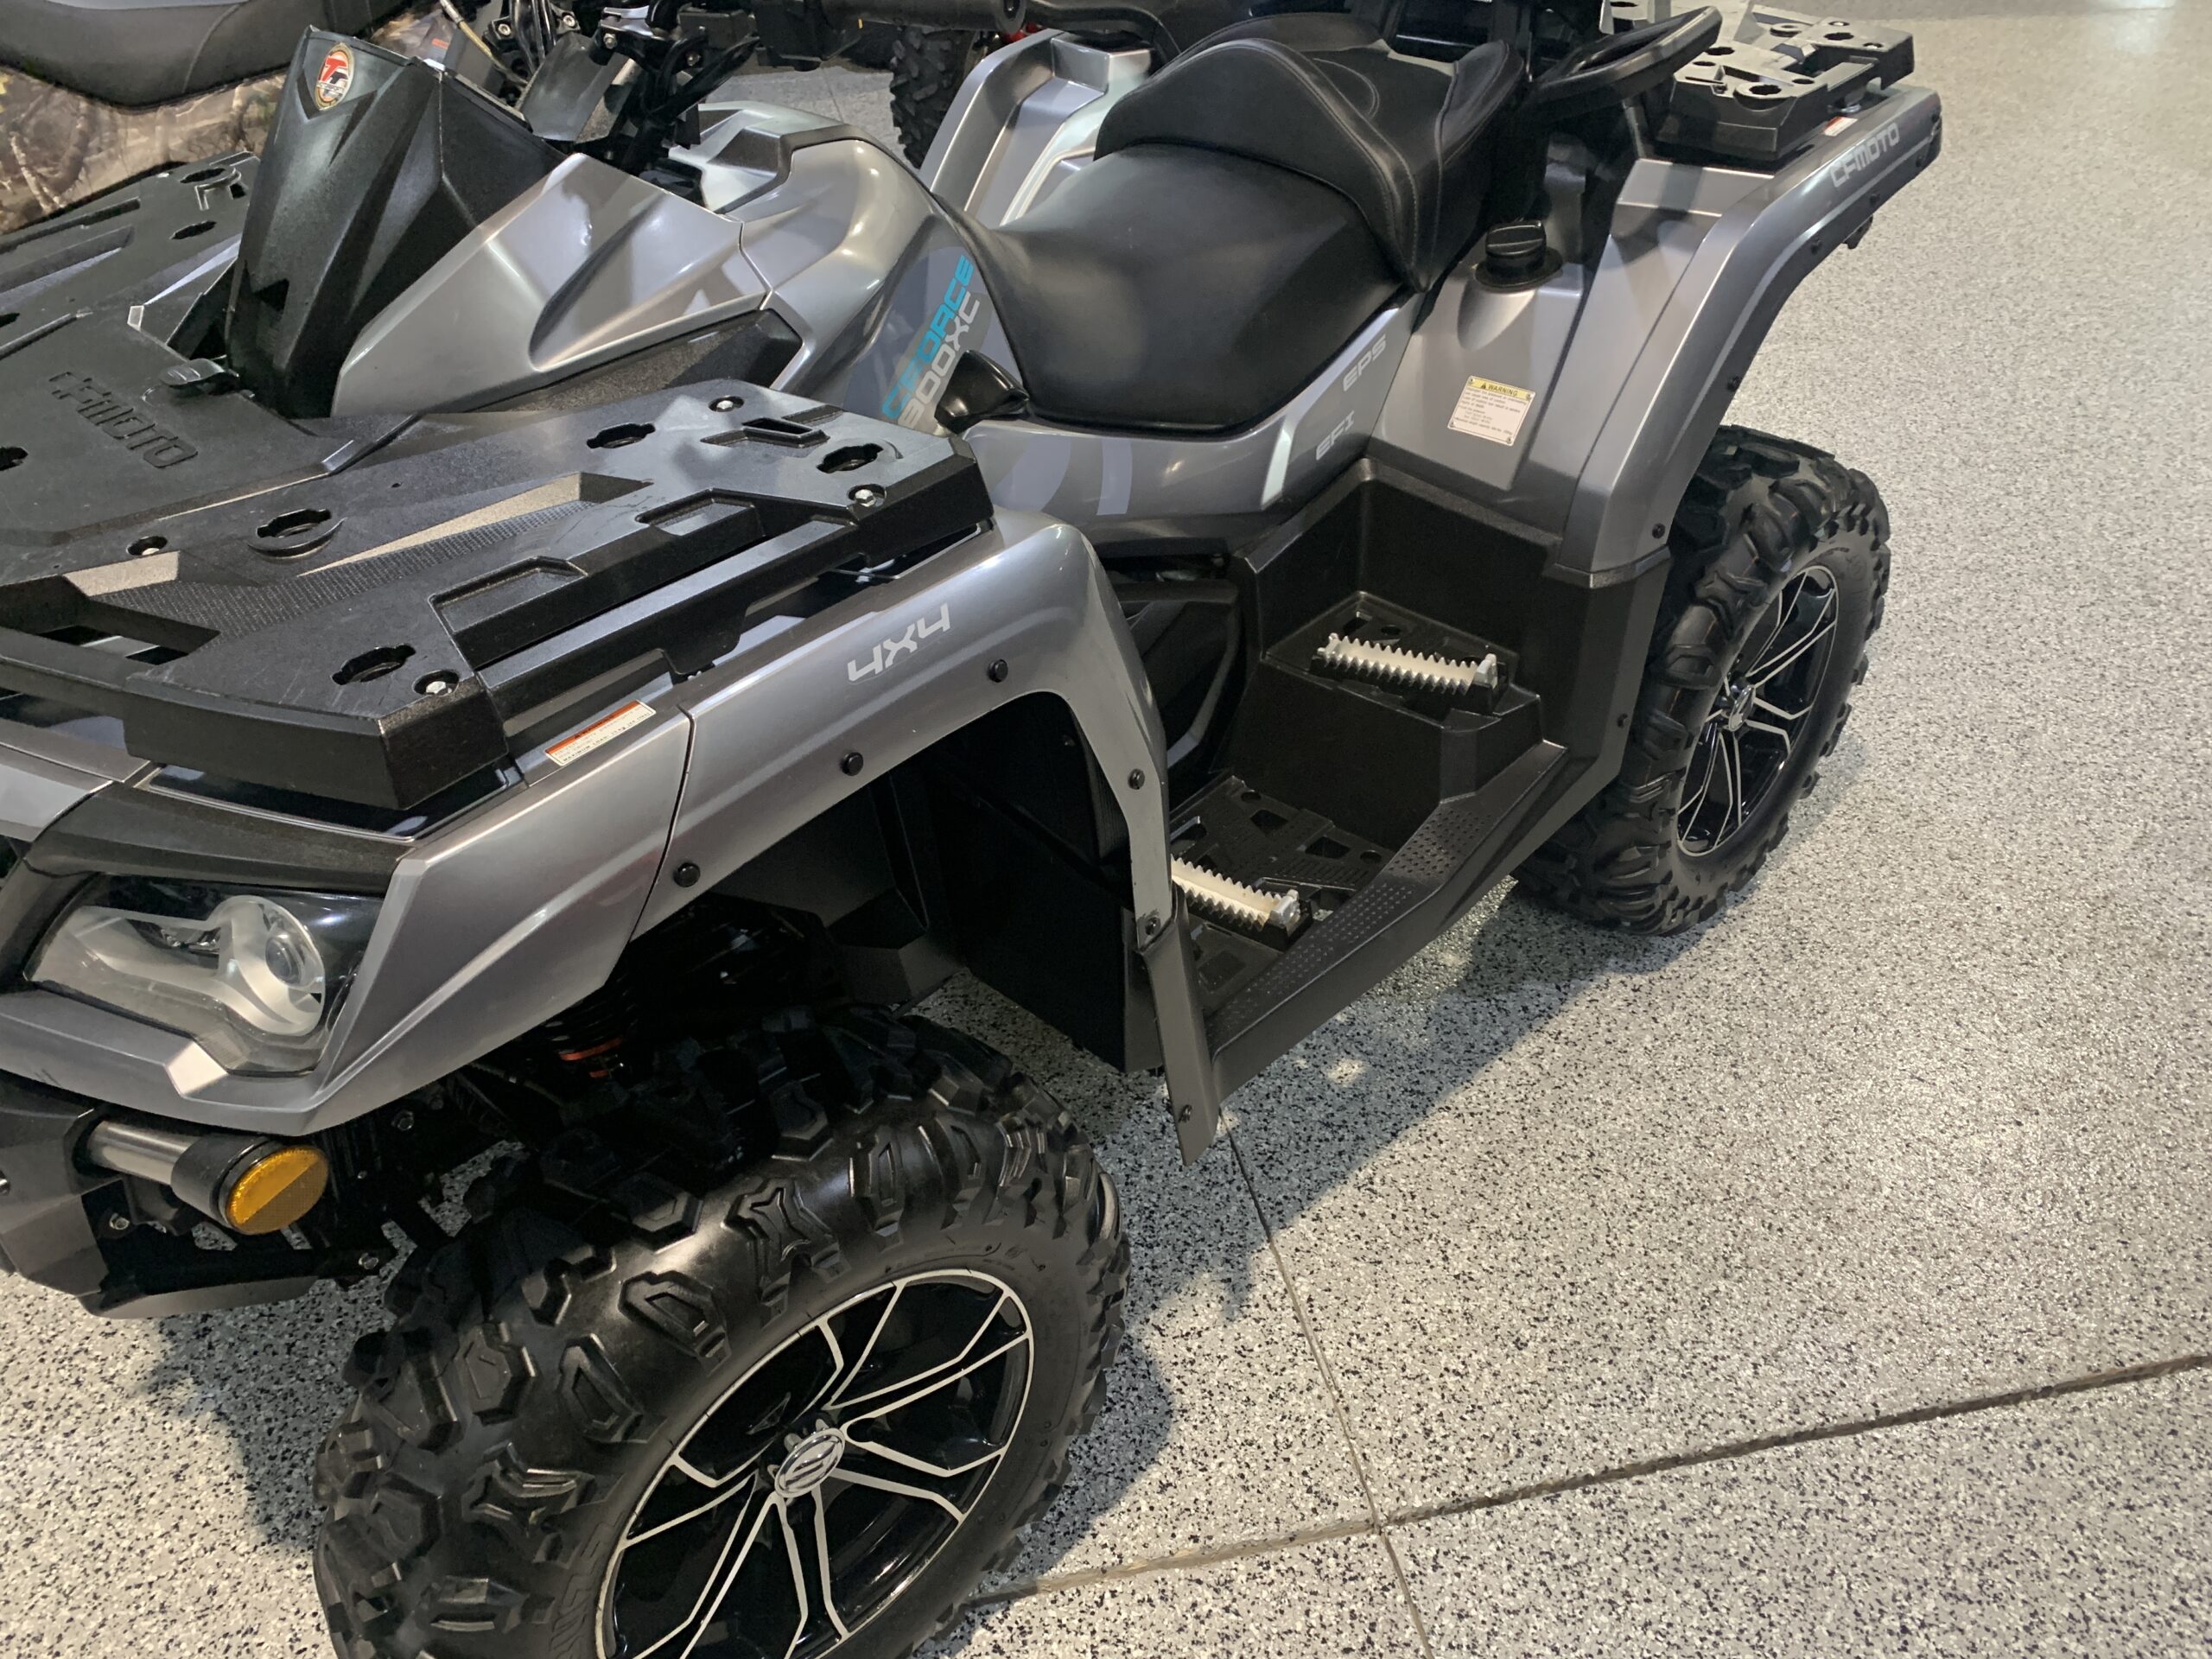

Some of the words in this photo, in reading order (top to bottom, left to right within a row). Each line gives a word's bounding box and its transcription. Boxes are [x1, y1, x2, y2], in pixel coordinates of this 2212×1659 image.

[1829, 122, 1900, 188] CFMOTO
[881, 255, 974, 419] CFORCE
[1343, 334, 1387, 391] EPS
[1488, 384, 1518, 397] WARNING
[1316, 410, 1355, 461] EFI
